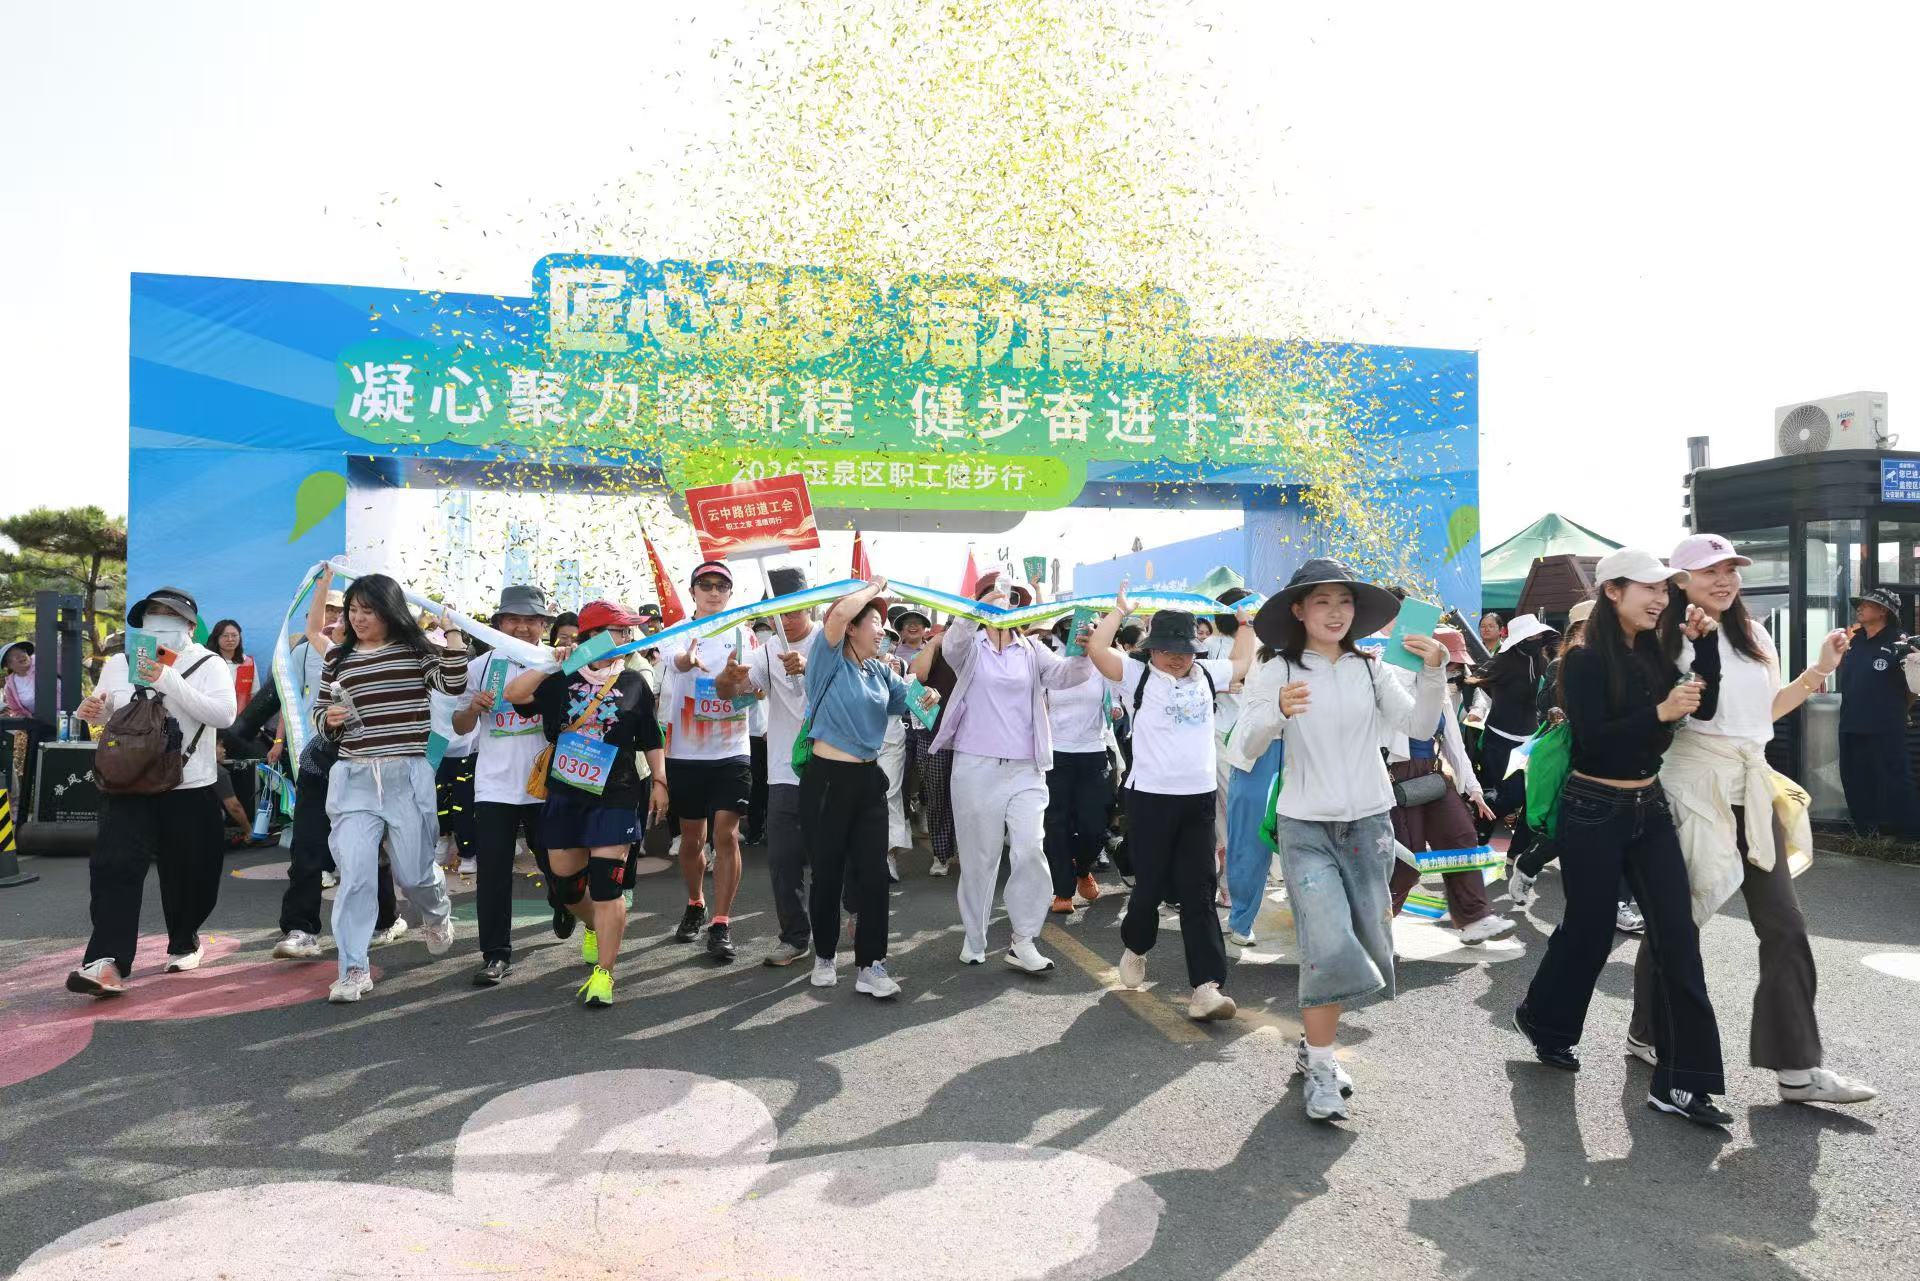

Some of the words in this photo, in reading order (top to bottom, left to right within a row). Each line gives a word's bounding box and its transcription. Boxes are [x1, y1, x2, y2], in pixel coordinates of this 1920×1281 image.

[550, 267, 857, 357] 匠心
[732, 458, 1026, 490] 2026玉泉区职工健步行
[1899, 470, 1920, 479] 您已进
[1899, 481, 1920, 490] 监控区
[707, 498, 793, 522] 云中路街道工会
[701, 699, 733, 713] 056
[558, 754, 601, 782] 0302
